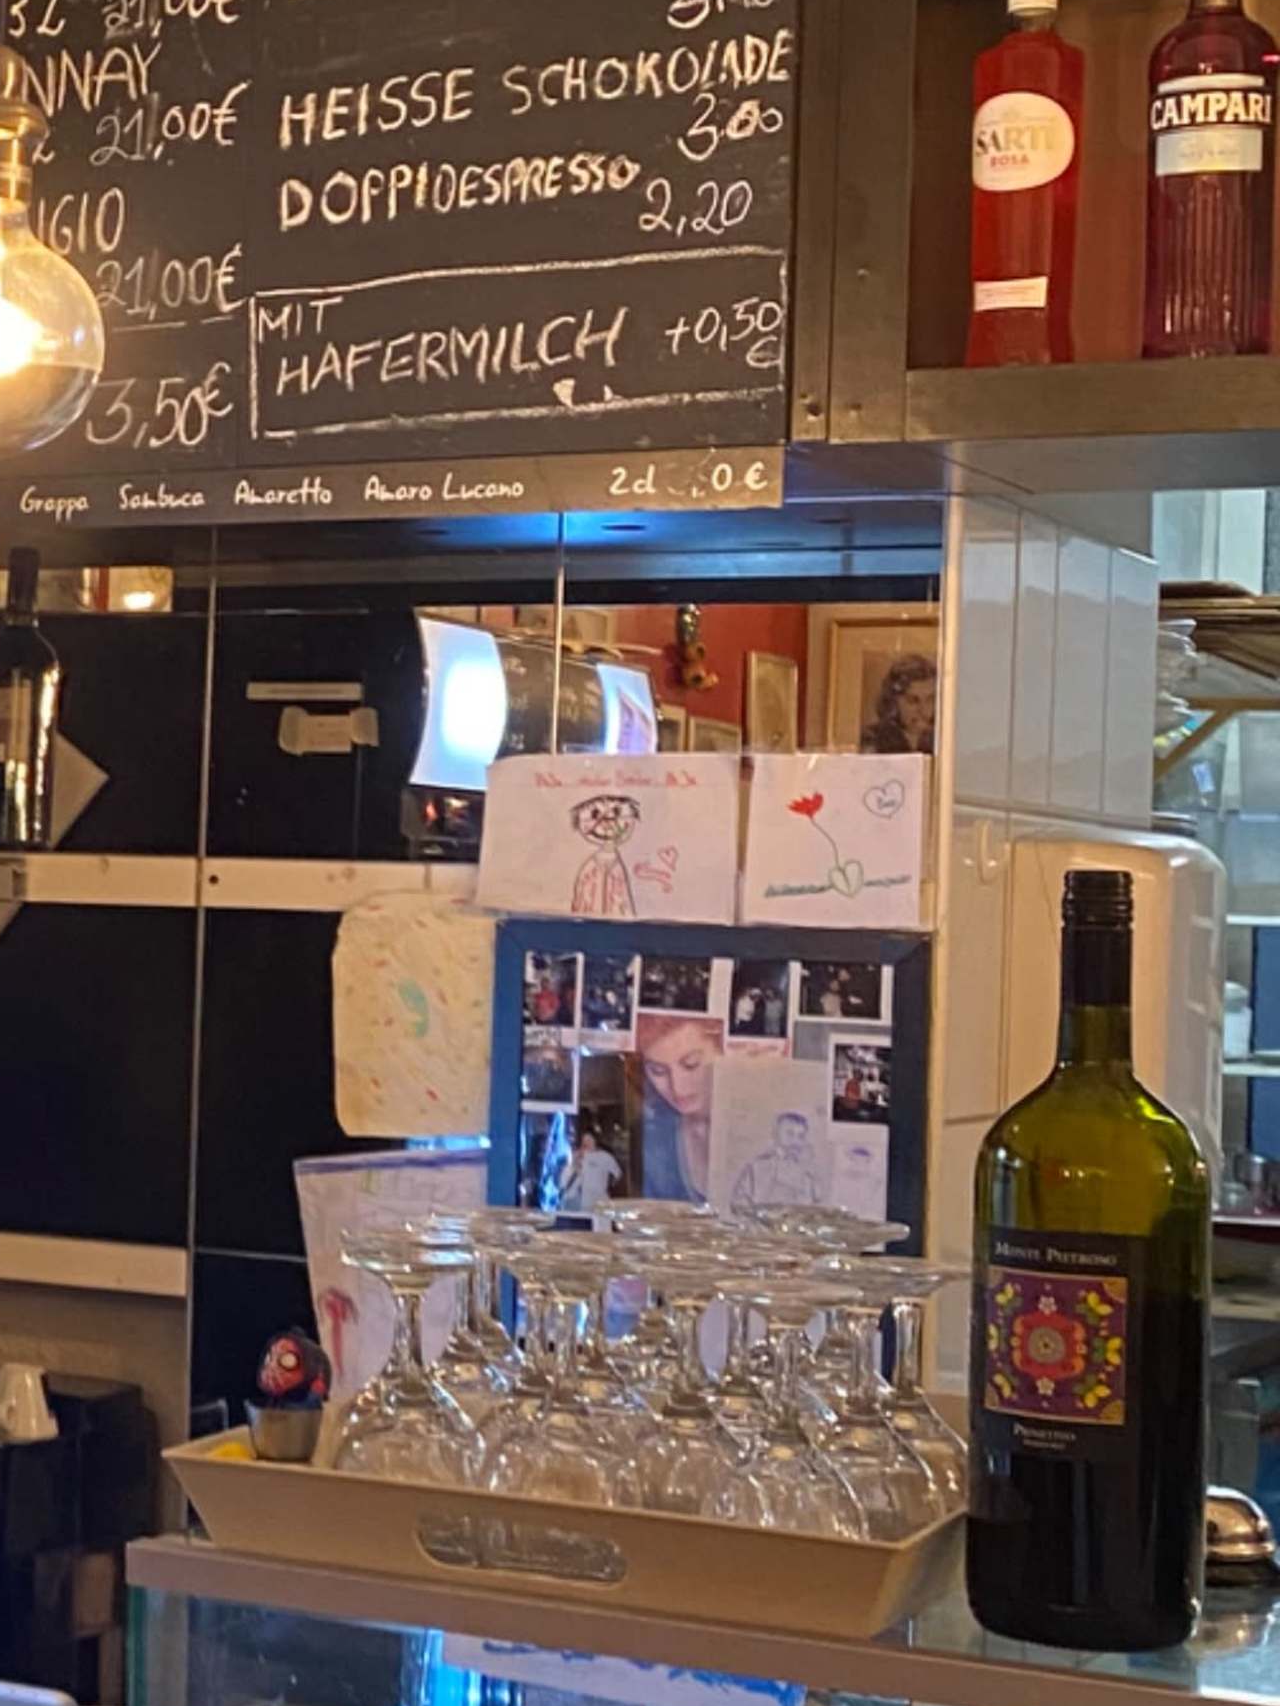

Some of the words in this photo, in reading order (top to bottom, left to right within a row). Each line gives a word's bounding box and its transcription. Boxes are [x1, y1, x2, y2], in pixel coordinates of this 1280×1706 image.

[280, 68, 474, 149] HEISSE
[502, 28, 796, 116] SCHOKOLADE
[1150, 91, 1272, 131] CAMPARI
[640, 178, 754, 236] 2,20
[255, 298, 343, 345] MIT
[276, 306, 630, 396] HAFERMILCH
[20, 485, 90, 523] Grappa
[119, 482, 205, 509] Sambuca
